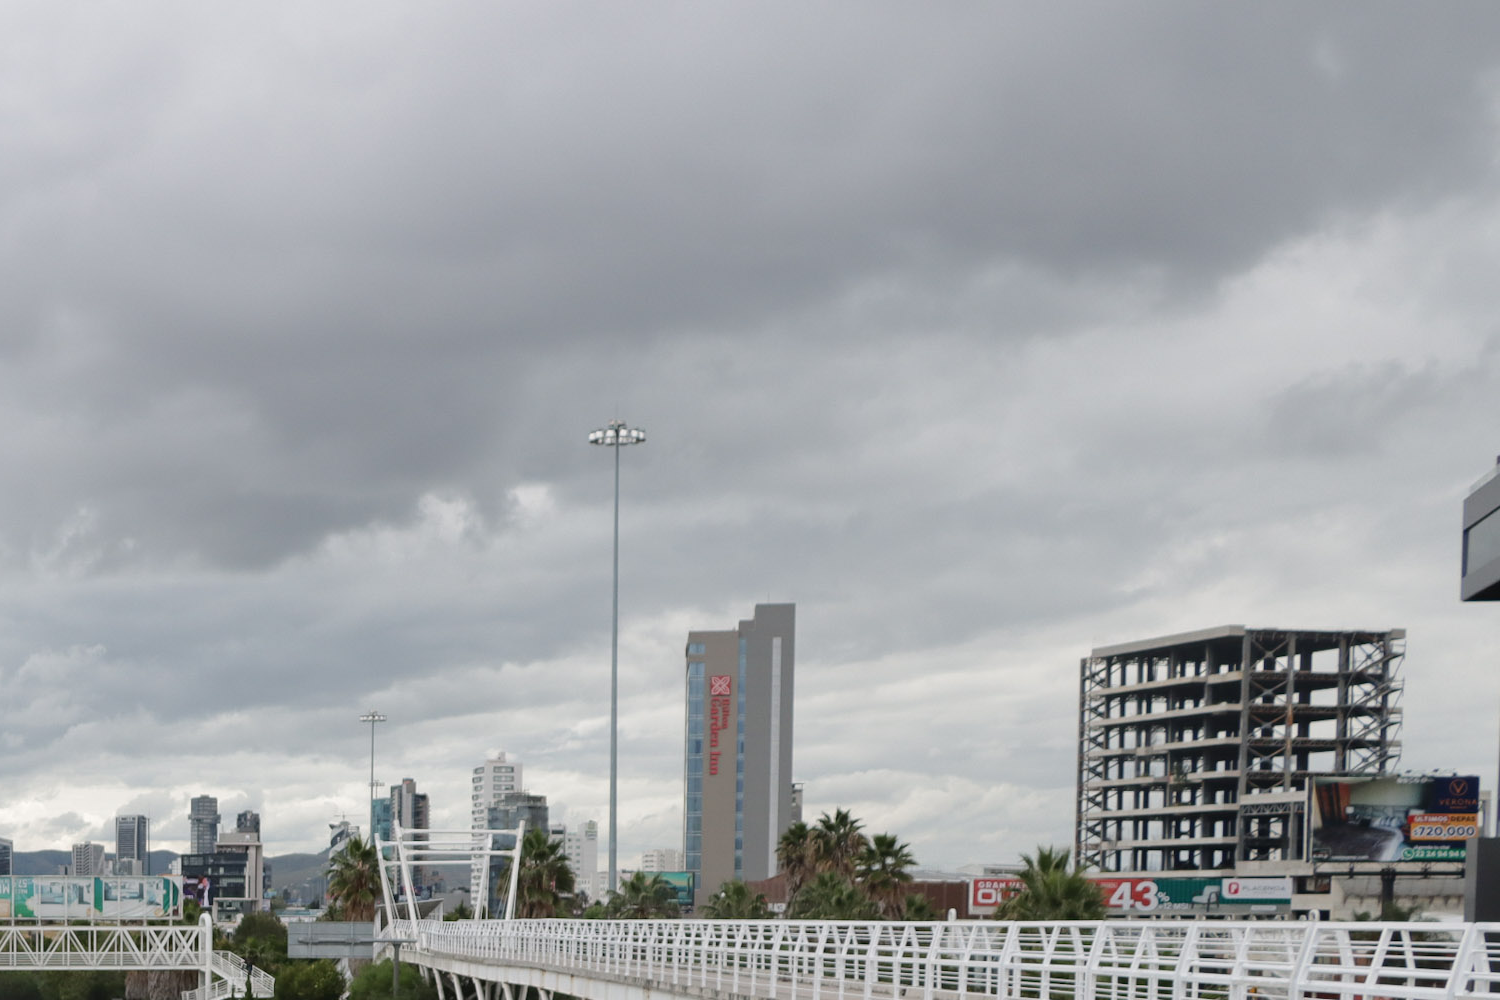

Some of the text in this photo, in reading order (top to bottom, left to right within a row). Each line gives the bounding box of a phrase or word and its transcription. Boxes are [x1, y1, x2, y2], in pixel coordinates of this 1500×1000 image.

[722, 697, 731, 729] Hilton
[709, 697, 722, 775] Garden Inn
[1439, 798, 1477, 806] VERONA
[1450, 814, 1476, 822] DEPAS
[1413, 825, 1476, 837] $720,000
[978, 881, 1006, 889] GRAN
